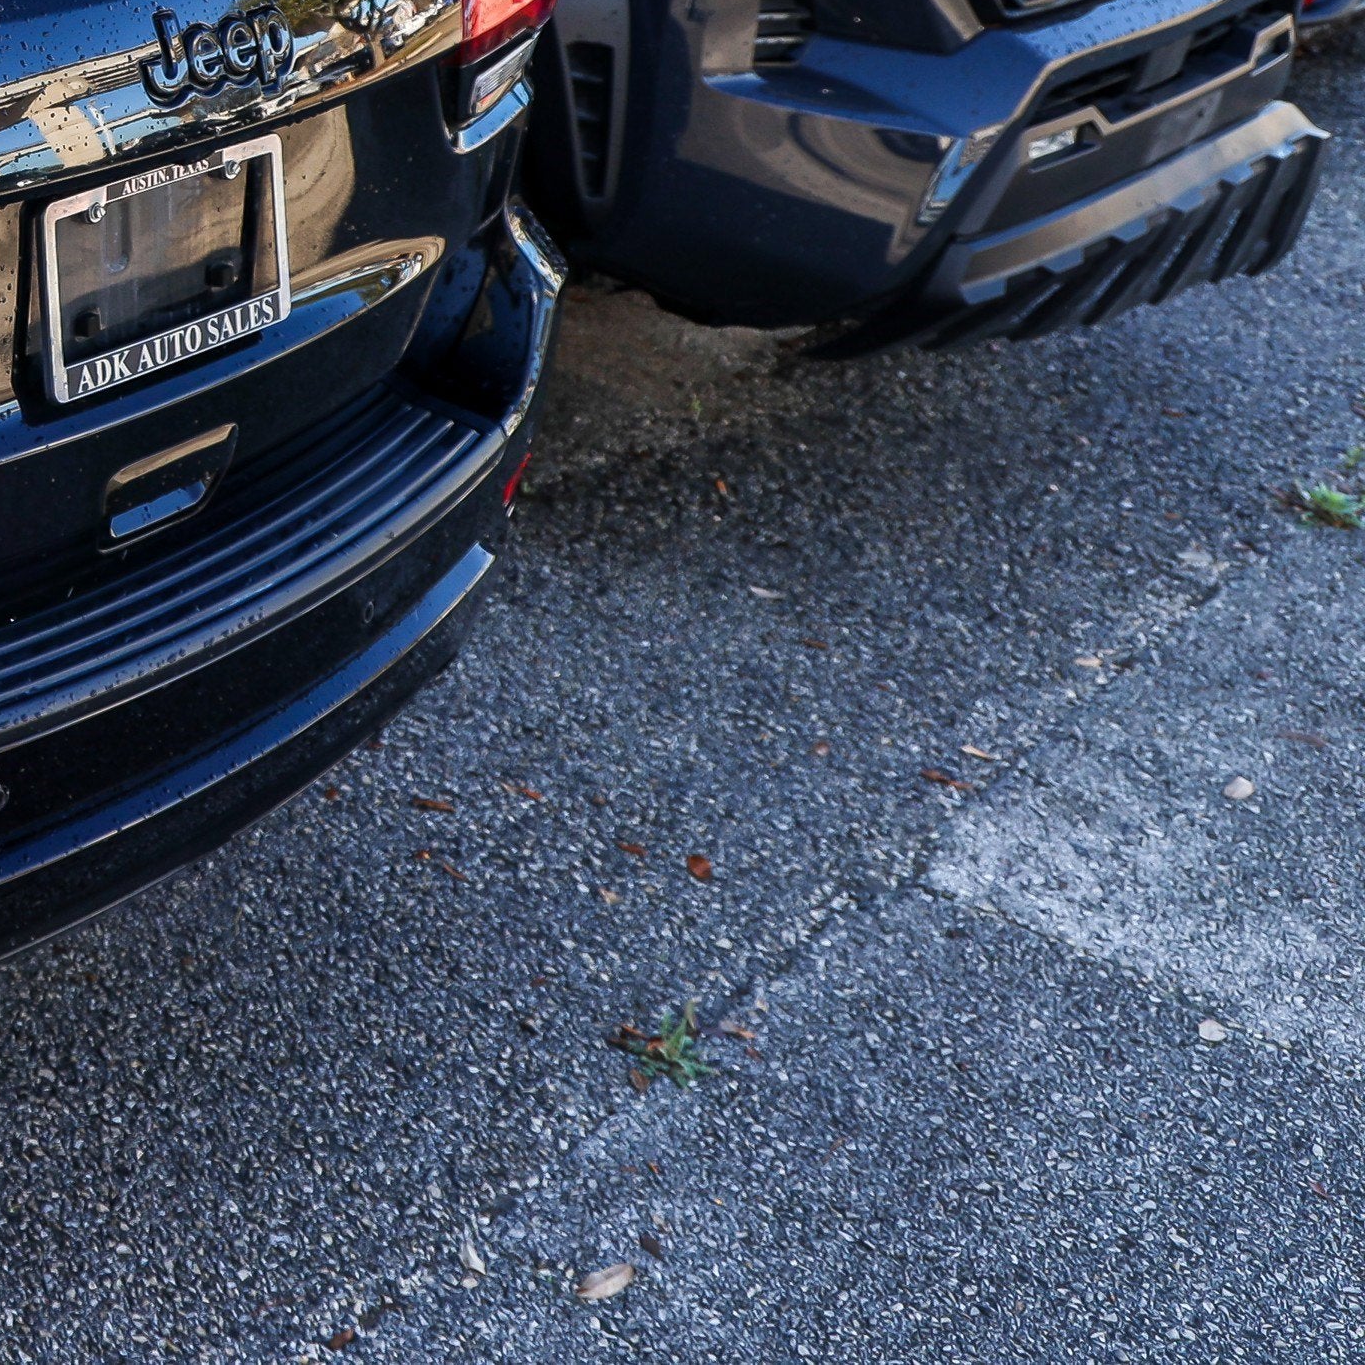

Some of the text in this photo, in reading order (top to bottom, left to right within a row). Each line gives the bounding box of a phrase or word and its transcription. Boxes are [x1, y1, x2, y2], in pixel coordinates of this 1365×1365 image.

[139, 3, 294, 109] Jeep
[77, 297, 275, 393] ADK AUTO SALES
